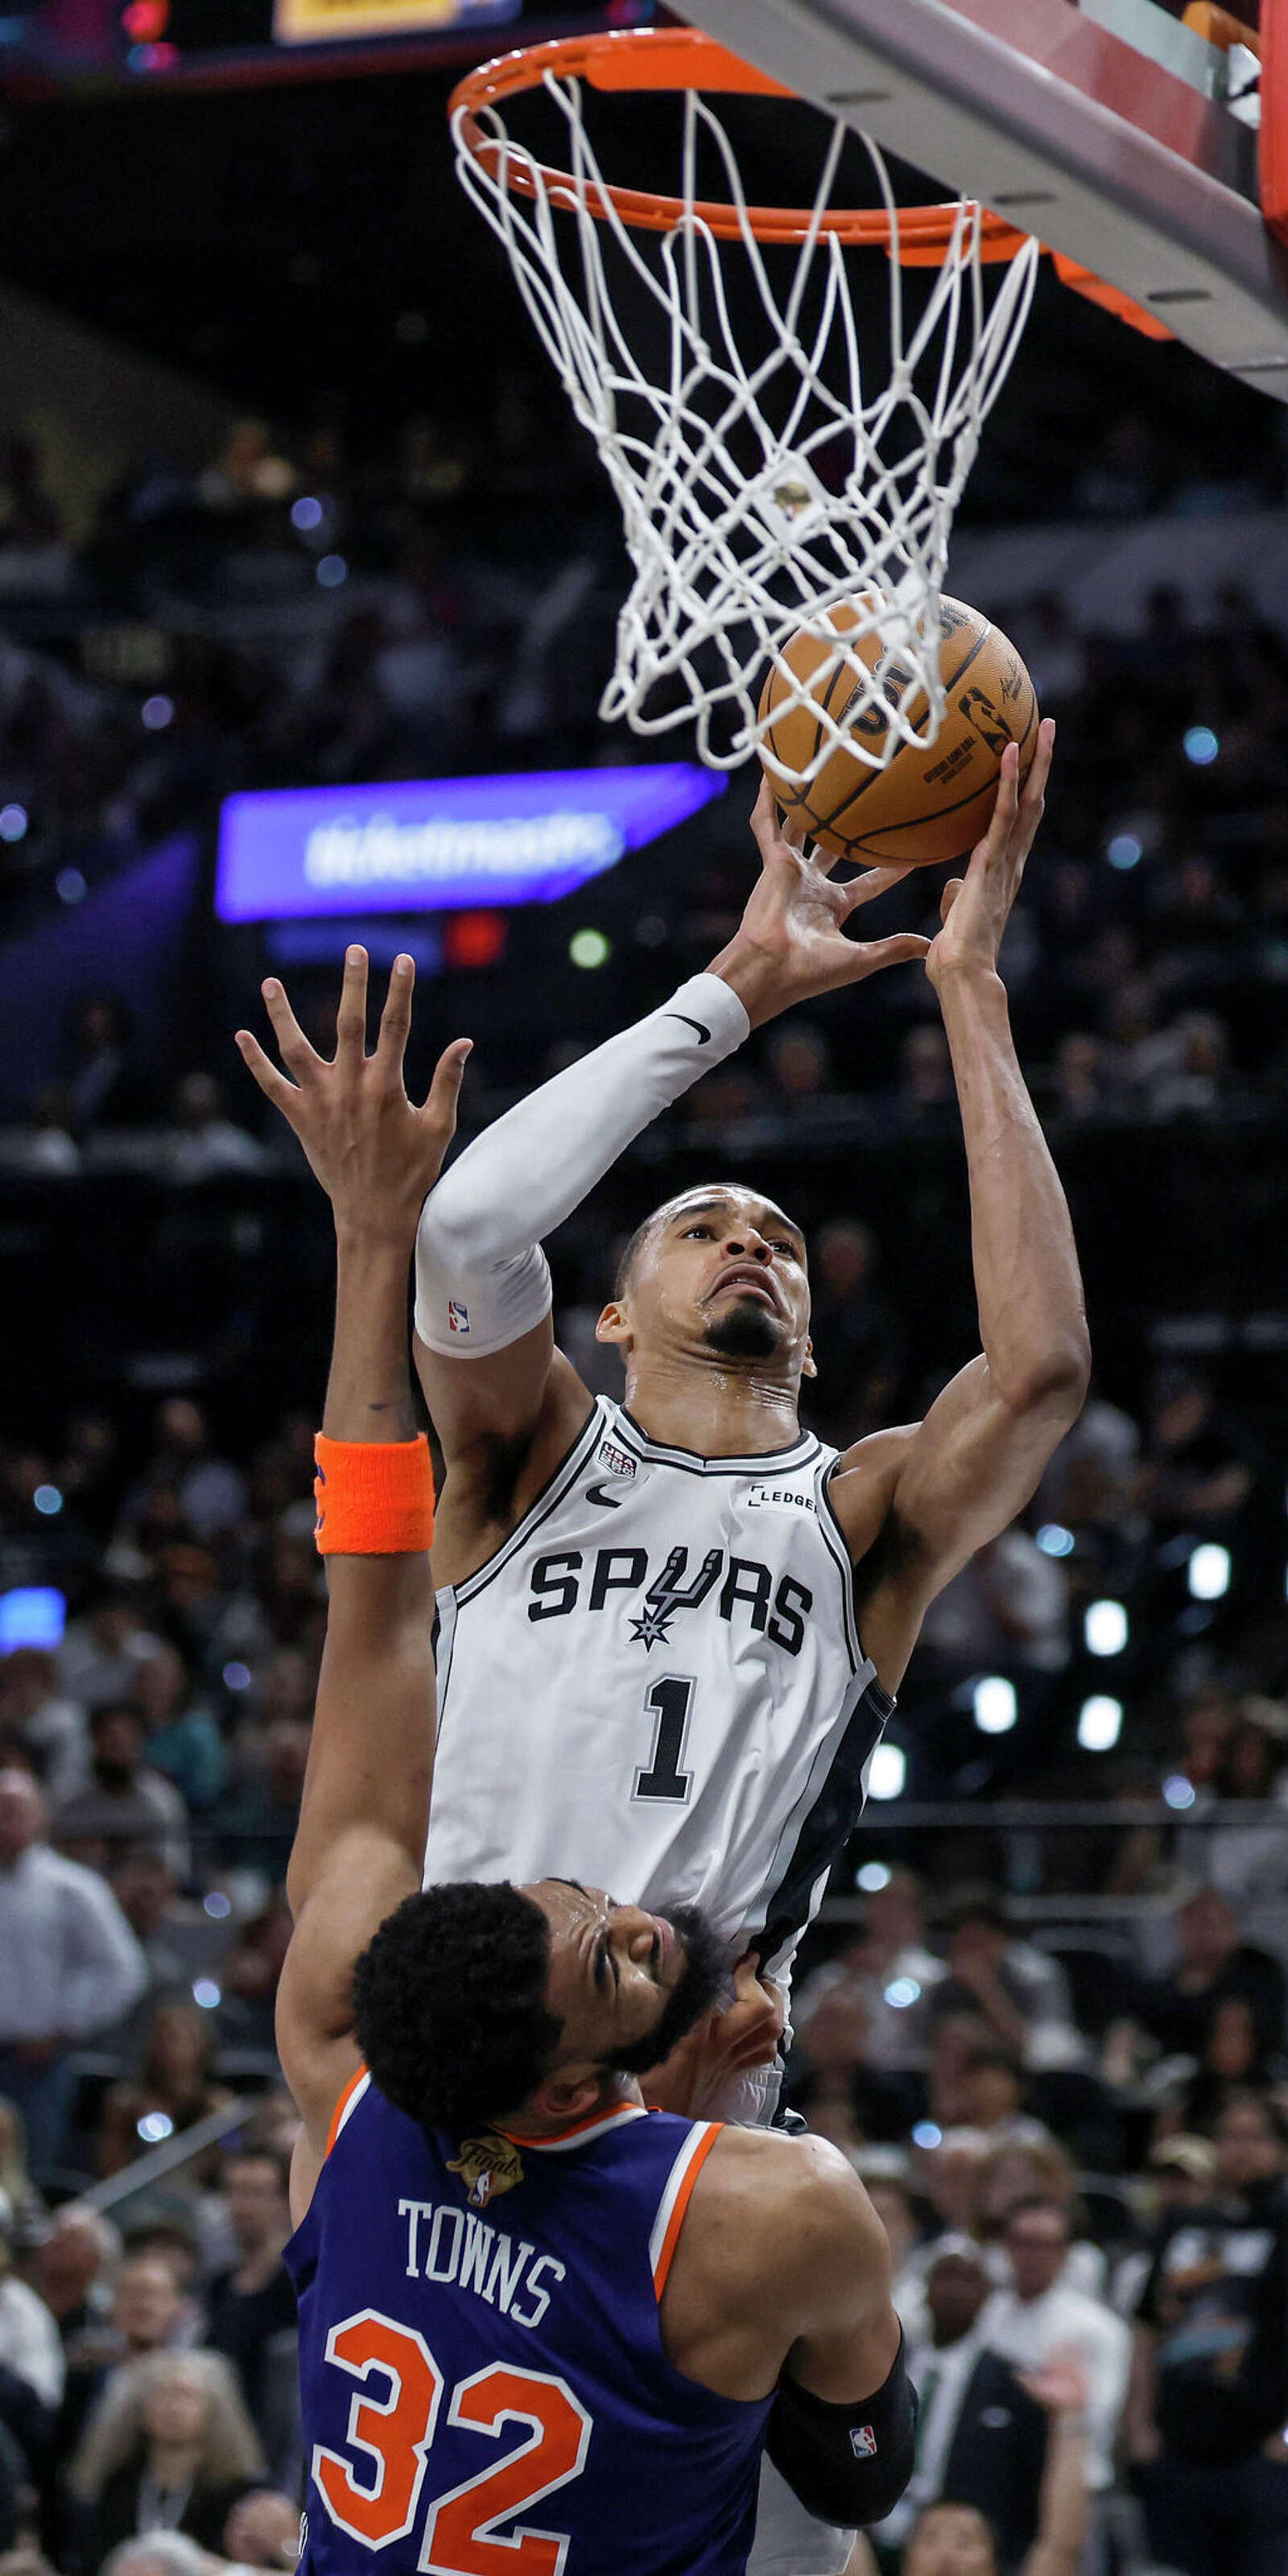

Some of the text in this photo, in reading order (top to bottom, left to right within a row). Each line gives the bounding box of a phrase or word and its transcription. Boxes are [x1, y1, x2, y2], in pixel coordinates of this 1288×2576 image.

[528, 1546, 813, 1657] SPURS
[630, 1672, 698, 1806] 1
[448, 2142, 518, 2176] Finals
[398, 2198, 567, 2329] TOWNS
[311, 2307, 594, 2576] 32
